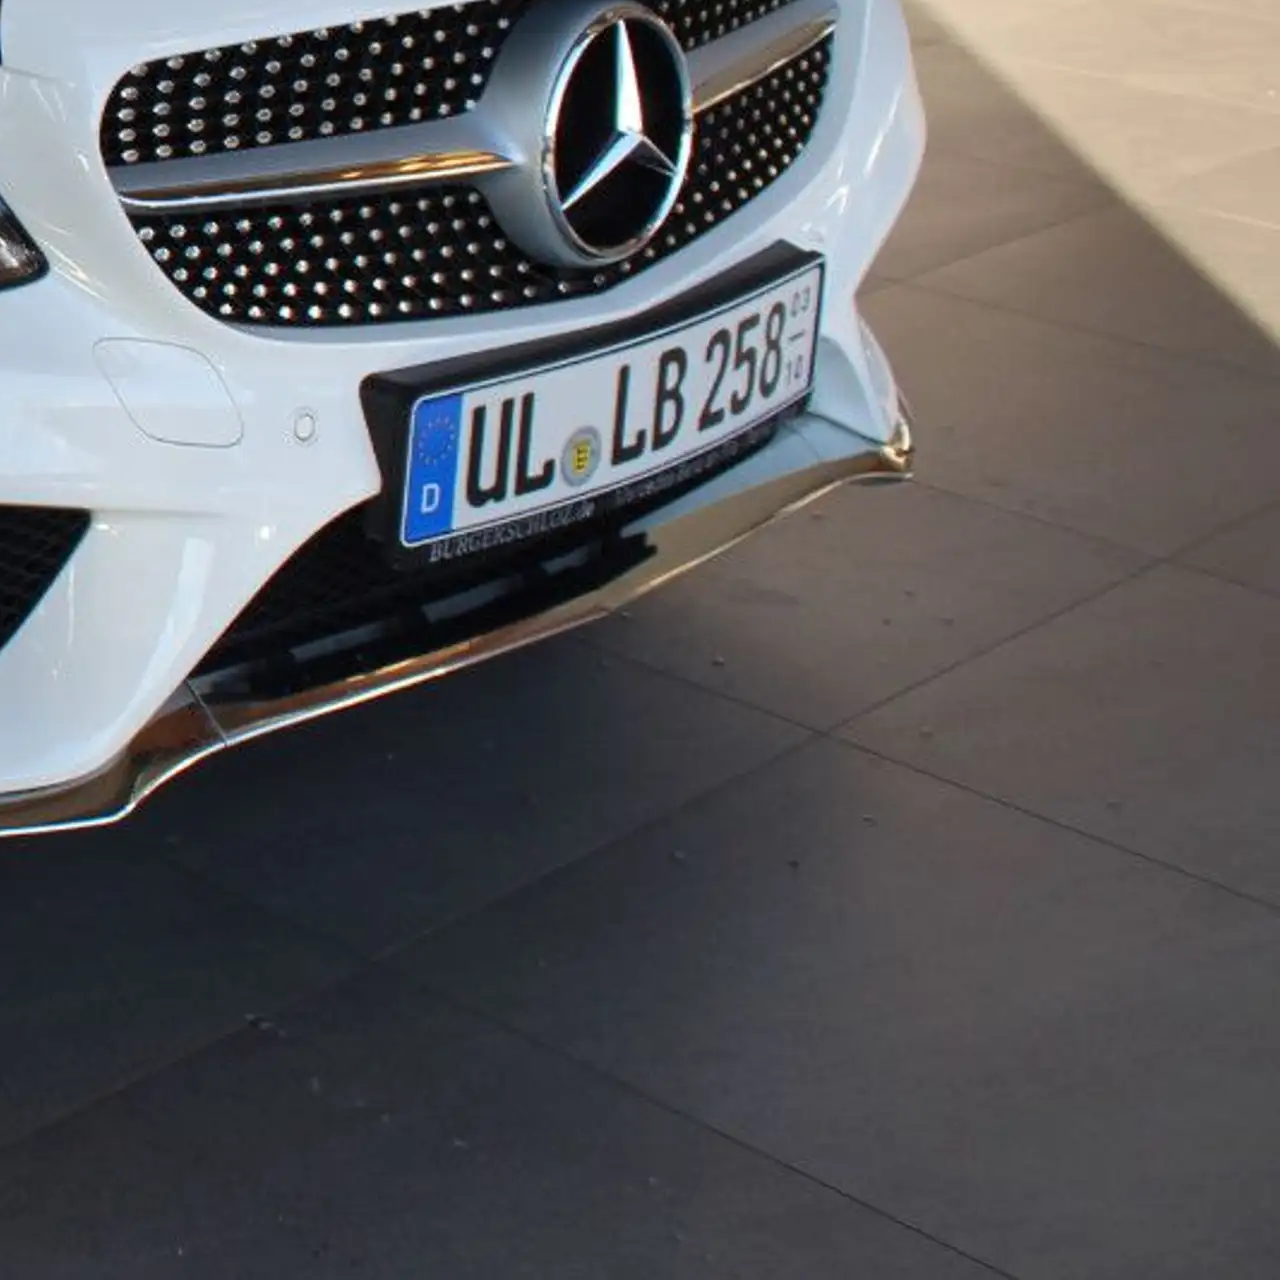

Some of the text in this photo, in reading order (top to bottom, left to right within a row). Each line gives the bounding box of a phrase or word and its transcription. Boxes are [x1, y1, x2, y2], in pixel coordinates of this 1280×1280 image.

[466, 392, 555, 508] UL
[611, 346, 689, 465] LB
[698, 301, 786, 432] 258
[420, 483, 440, 513] D
